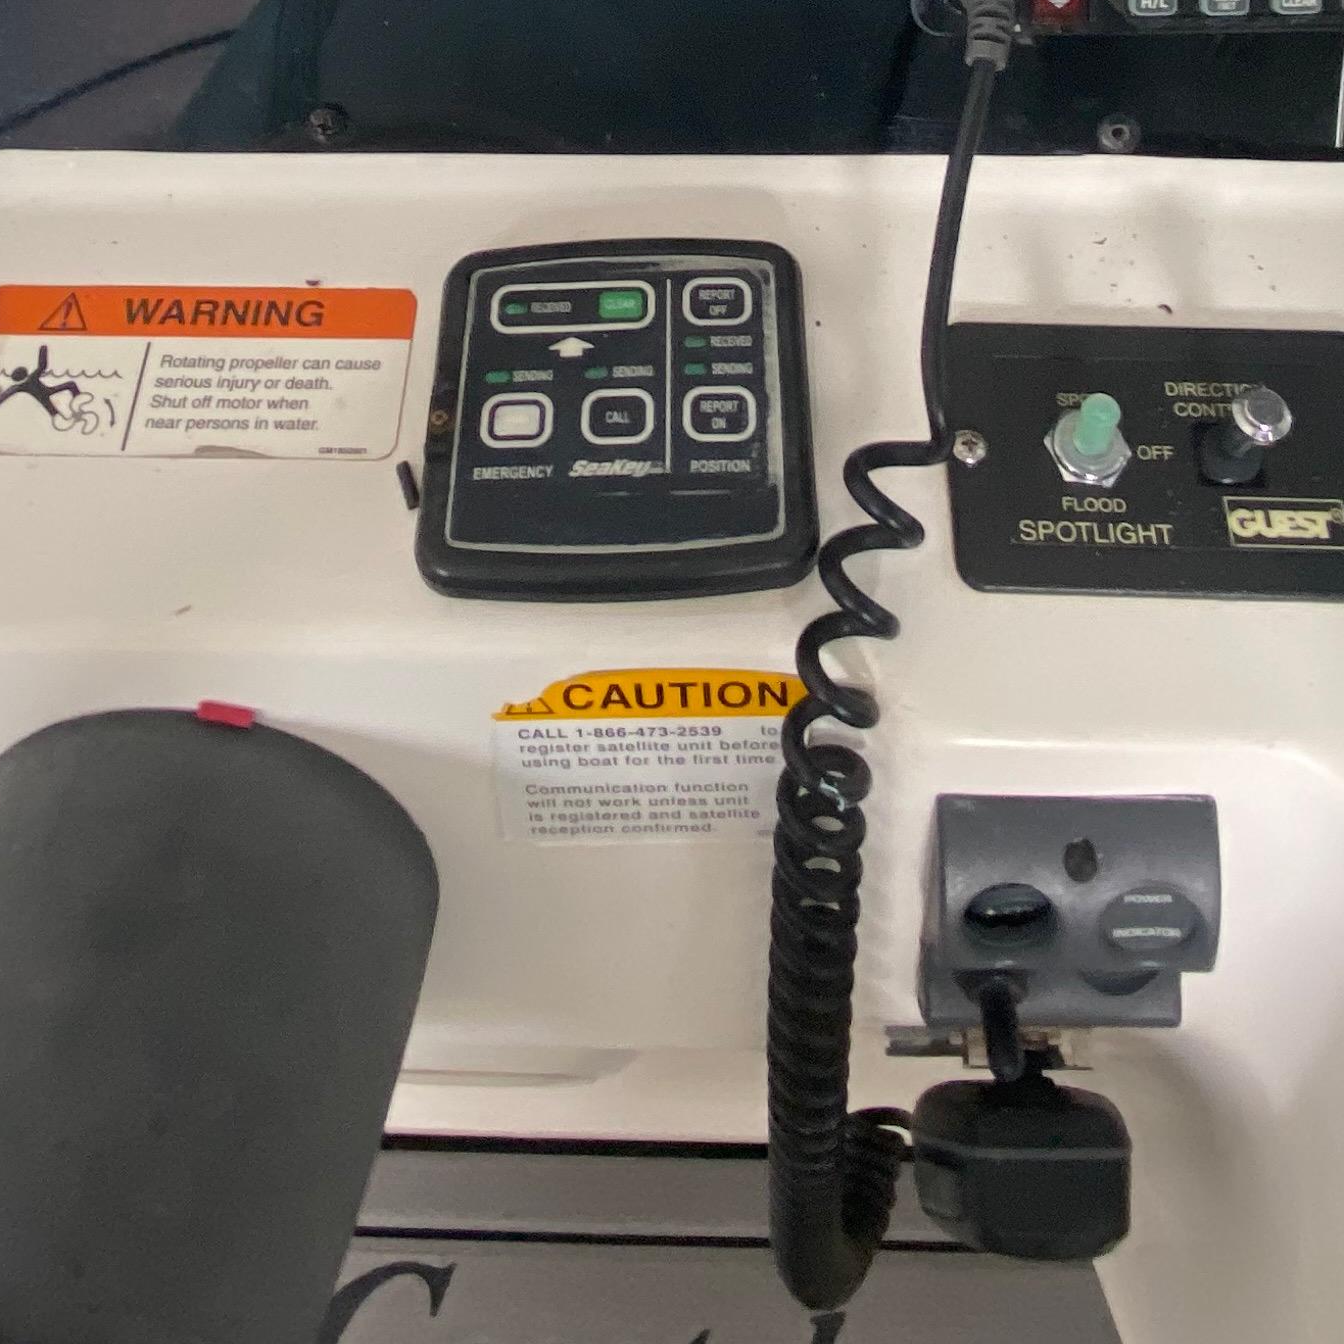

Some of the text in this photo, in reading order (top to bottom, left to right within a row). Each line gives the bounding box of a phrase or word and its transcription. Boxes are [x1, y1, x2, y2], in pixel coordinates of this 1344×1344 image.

[699, 289, 735, 300] REPORT
[124, 297, 327, 328] WARNING
[160, 355, 381, 373] Rotating propeller can cause
[612, 365, 654, 377] SENDING
[711, 362, 753, 374] SENDING
[513, 370, 554, 382] SENDING
[154, 376, 334, 392] serious injury or death.
[1164, 382, 1256, 398] DIRECTI
[150, 394, 309, 410] Shut off motor when
[699, 400, 739, 413] REPORT
[1056, 393, 1086, 407] SP
[605, 411, 630, 424] CALL
[1172, 402, 1233, 418] CONT
[145, 416, 318, 432] near persons in water.
[711, 417, 727, 429] ON
[1137, 445, 1175, 461] OFF
[472, 465, 554, 481] EMERGENCY
[568, 459, 652, 477] SeaKey
[690, 459, 751, 472] POSITION
[1062, 496, 1127, 513] FLOOD
[1018, 519, 1173, 545] SPOTLIGHT
[562, 681, 788, 711] CAUTION
[518, 725, 778, 739] CALL 1-866-473-2539 to
[519, 740, 781, 756] register satellite unit before
[522, 755, 775, 769] using boat for the first time
[525, 782, 749, 795] Communication function
[528, 796, 749, 808] will not work unless unit
[529, 809, 760, 824] is registered and satellite
[530, 824, 615, 837] reception
